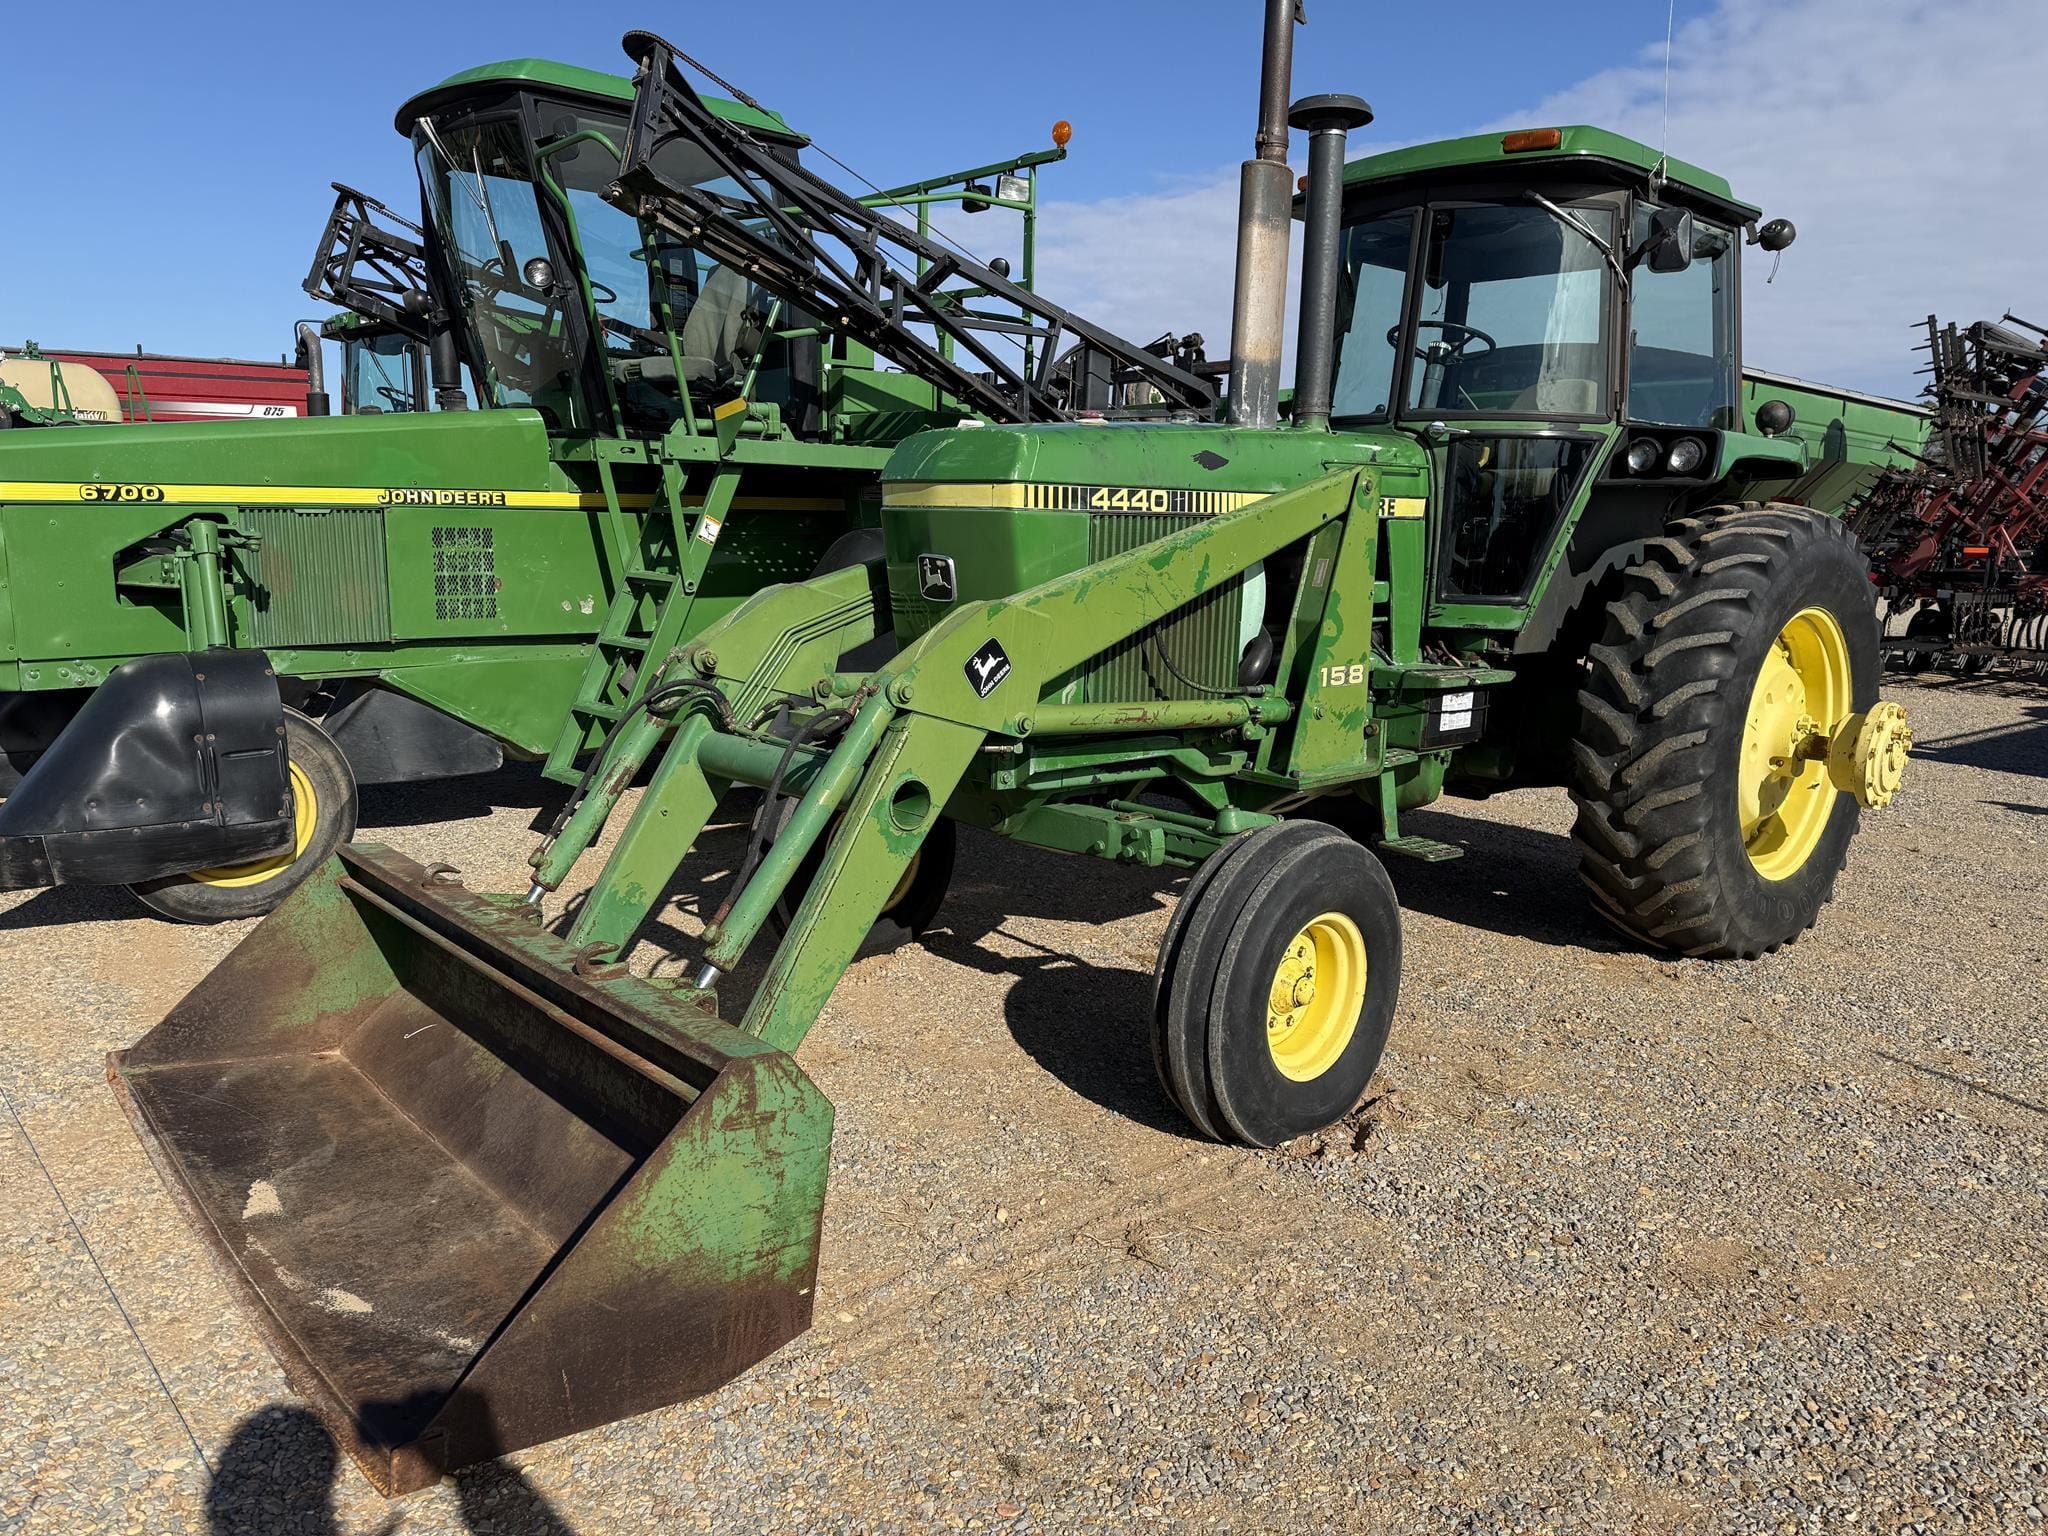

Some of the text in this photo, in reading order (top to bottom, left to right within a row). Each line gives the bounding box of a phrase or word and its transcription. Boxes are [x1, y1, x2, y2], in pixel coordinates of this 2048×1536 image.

[263, 406, 285, 416] 875
[80, 485, 164, 501] 6700
[378, 489, 505, 505] JOHN DEERE
[1092, 488, 1168, 512] 4440
[981, 663, 1011, 697] JOHN DEERE
[1320, 665, 1364, 687] 158
